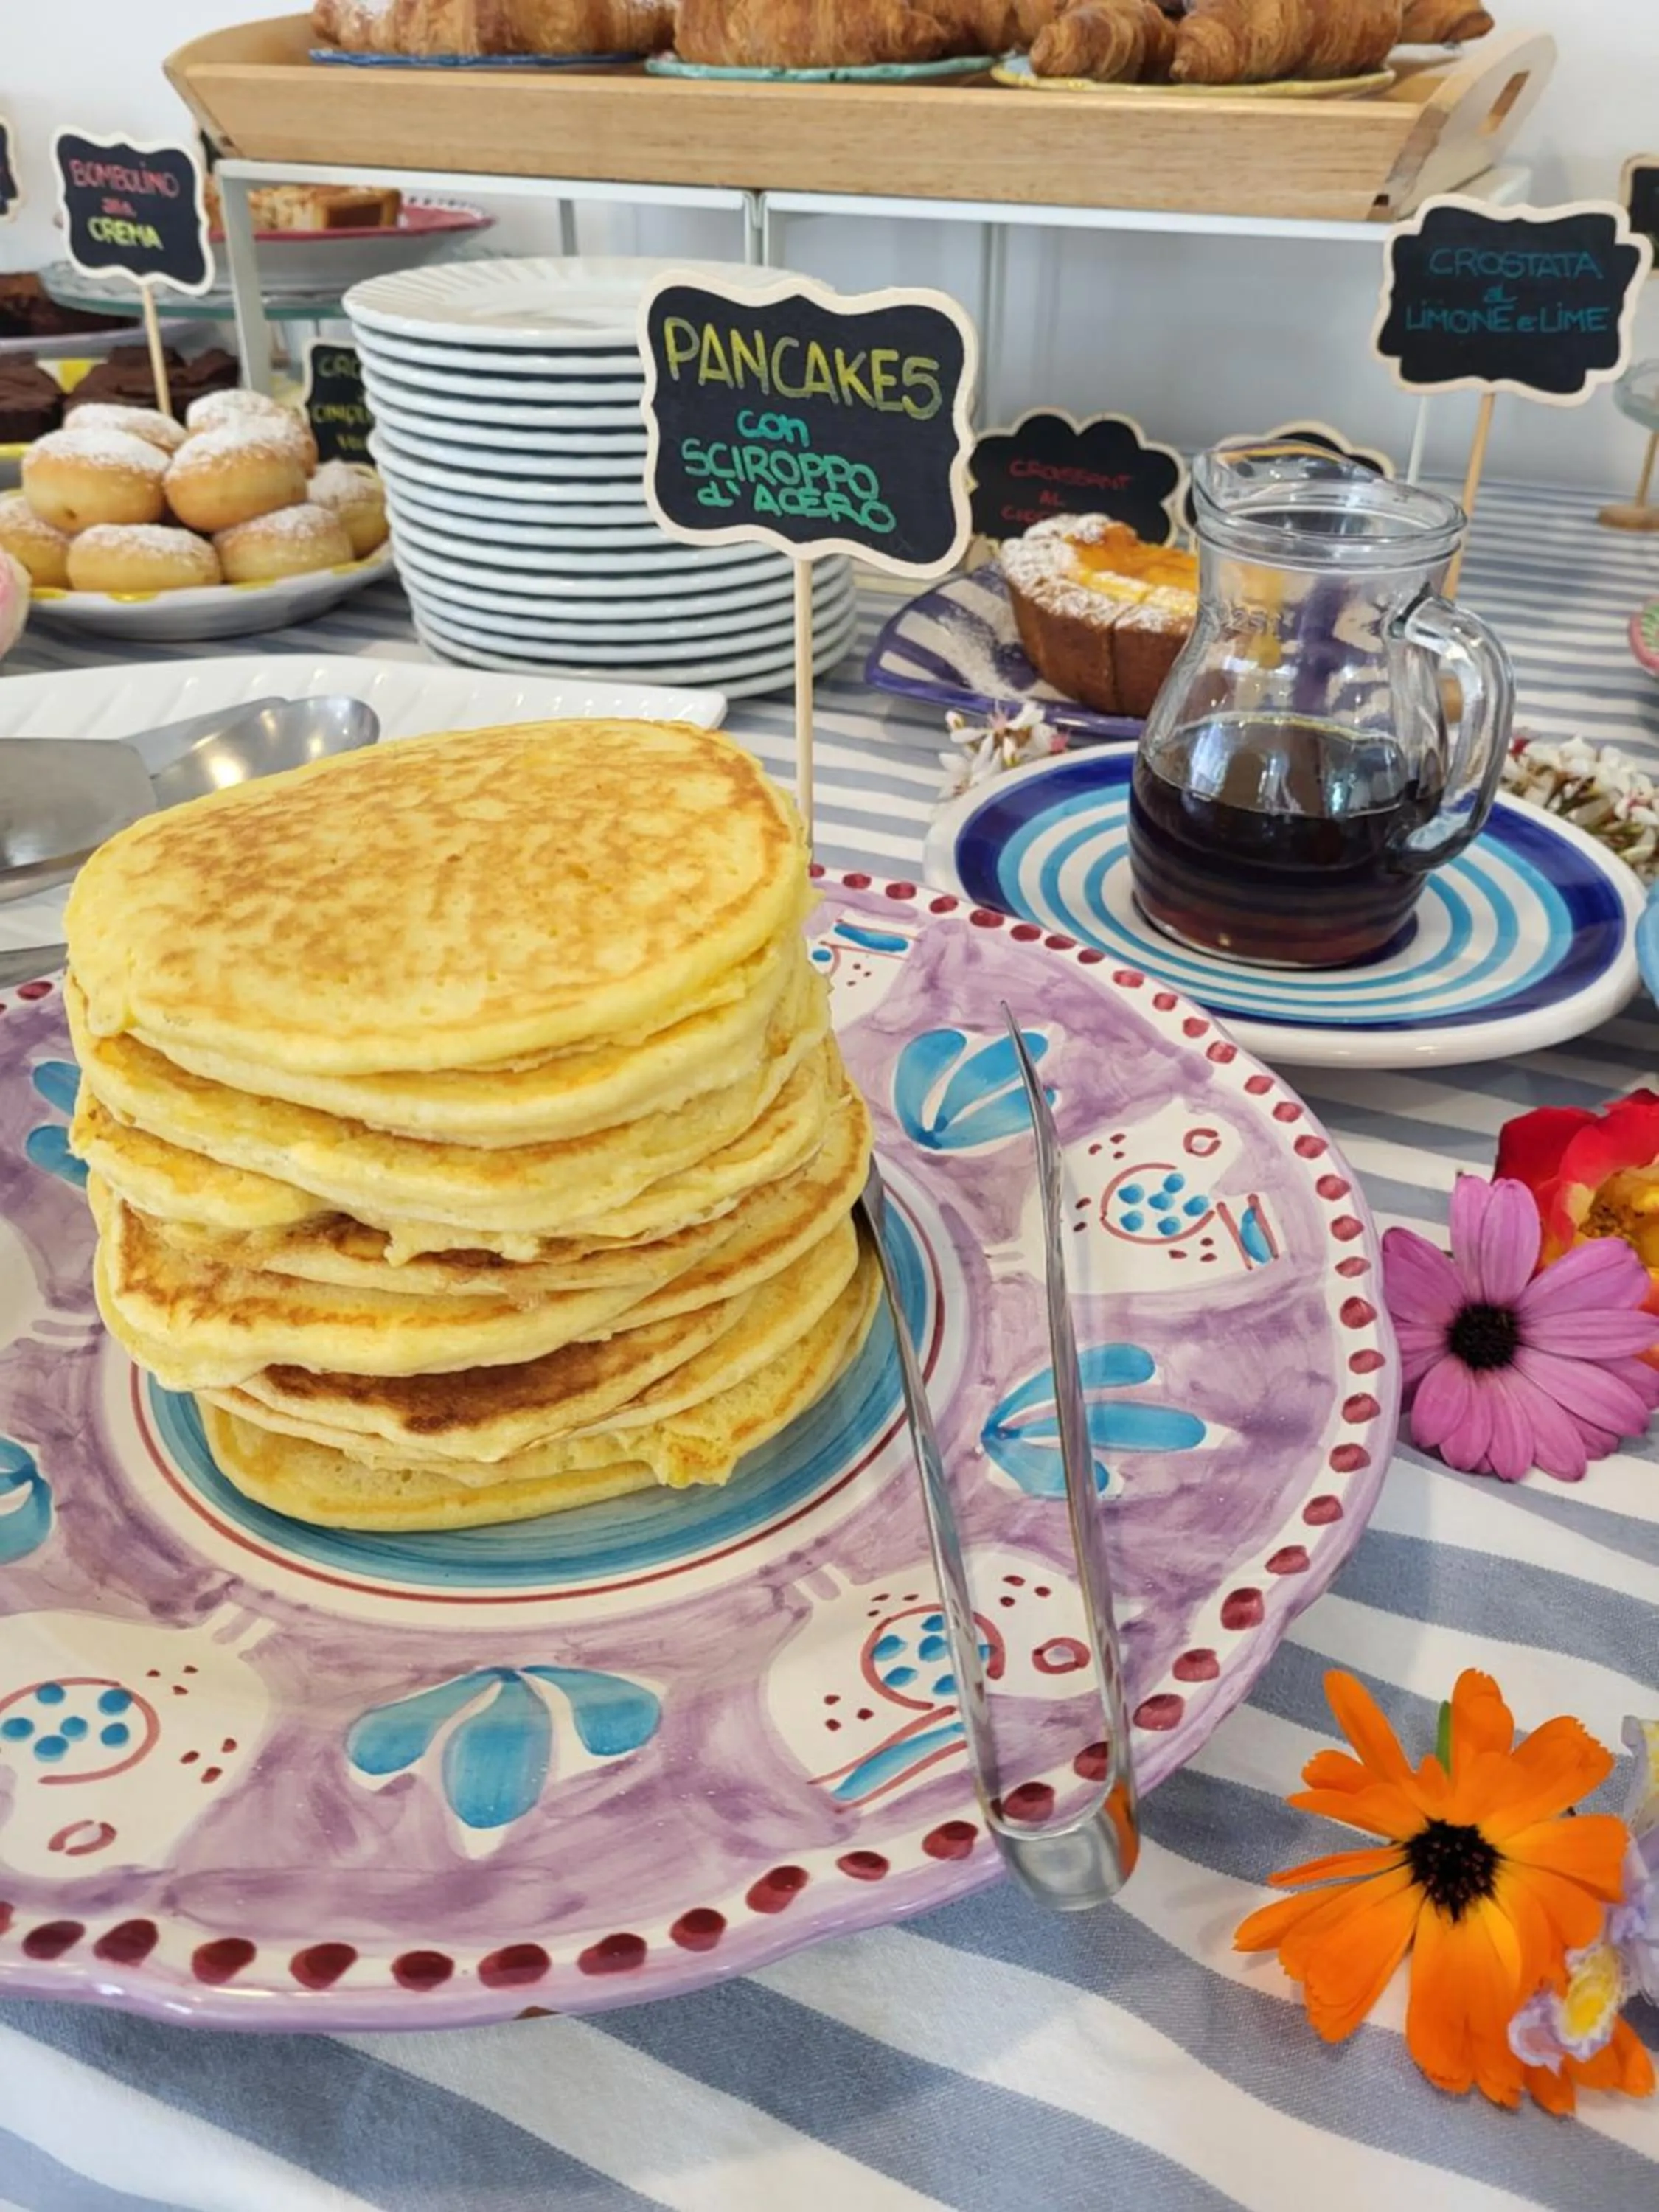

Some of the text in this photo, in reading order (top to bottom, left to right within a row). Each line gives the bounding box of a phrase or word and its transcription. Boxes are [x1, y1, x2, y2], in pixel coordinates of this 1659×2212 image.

[86, 216, 164, 251] CREMA
[1427, 247, 1604, 279] CROSTATA
[1405, 300, 1514, 333] LIMONE
[1540, 301, 1610, 333] LIME
[664, 316, 943, 420] PANCAKES
[737, 410, 810, 448] con
[681, 438, 879, 501] SCIROPPO
